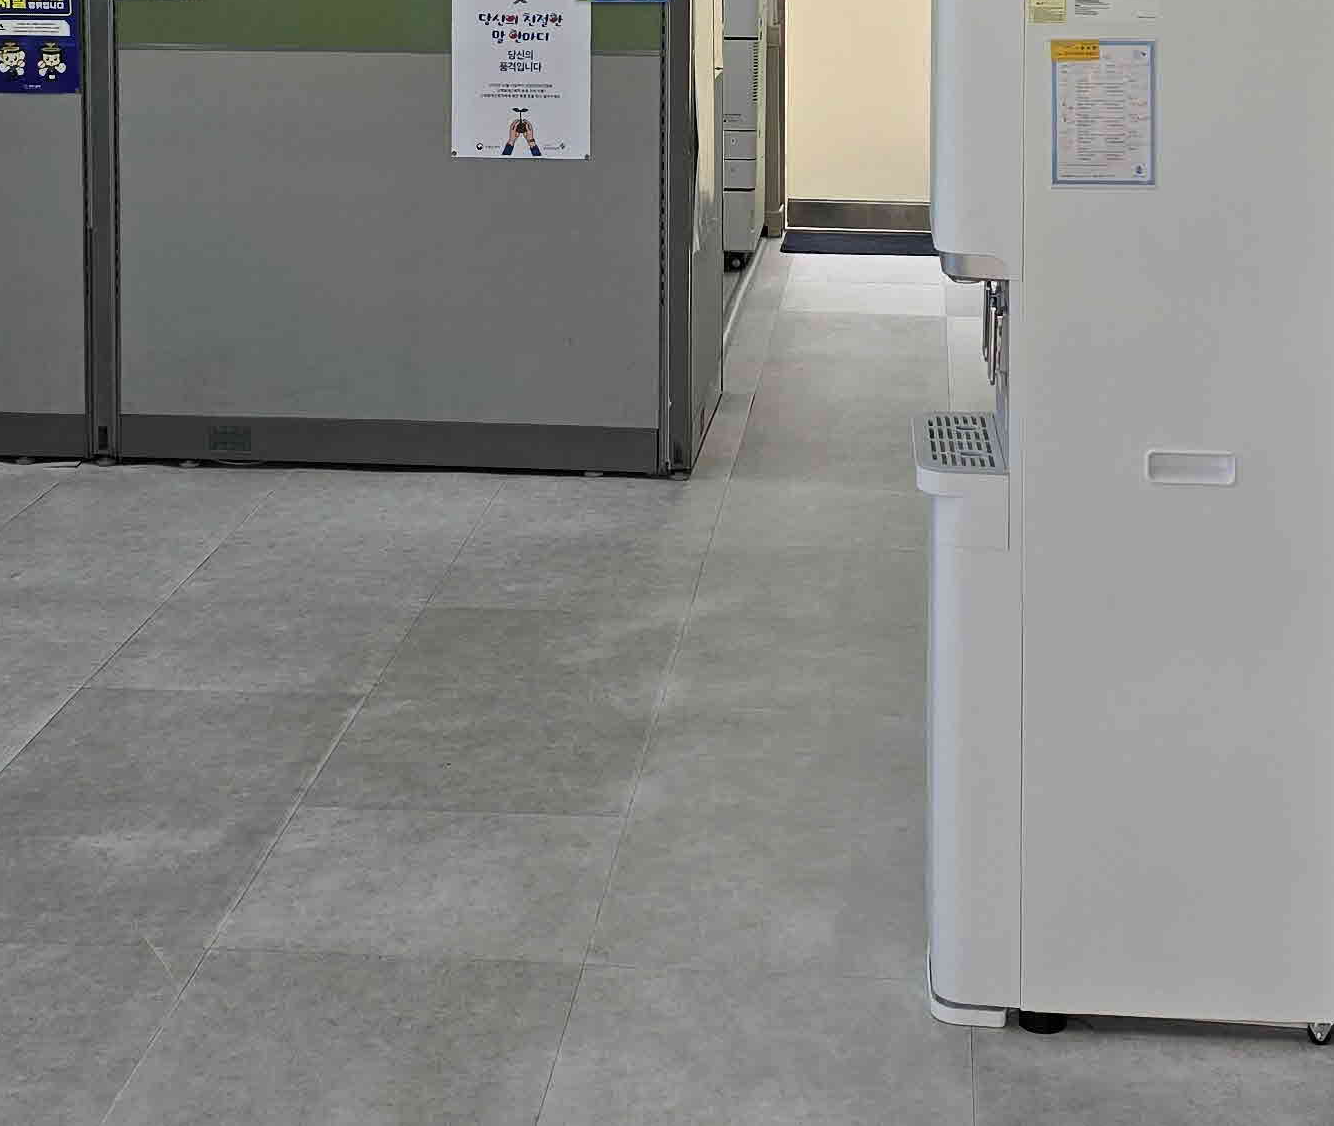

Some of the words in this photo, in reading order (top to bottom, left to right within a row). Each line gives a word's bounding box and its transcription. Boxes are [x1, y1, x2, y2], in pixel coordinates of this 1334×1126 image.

[478, 12, 519, 27] 당신의
[523, 13, 563, 27] 친절한
[508, 30, 549, 43] 한마디
[507, 50, 534, 61] 당신의
[499, 61, 542, 73] 품격입니다
